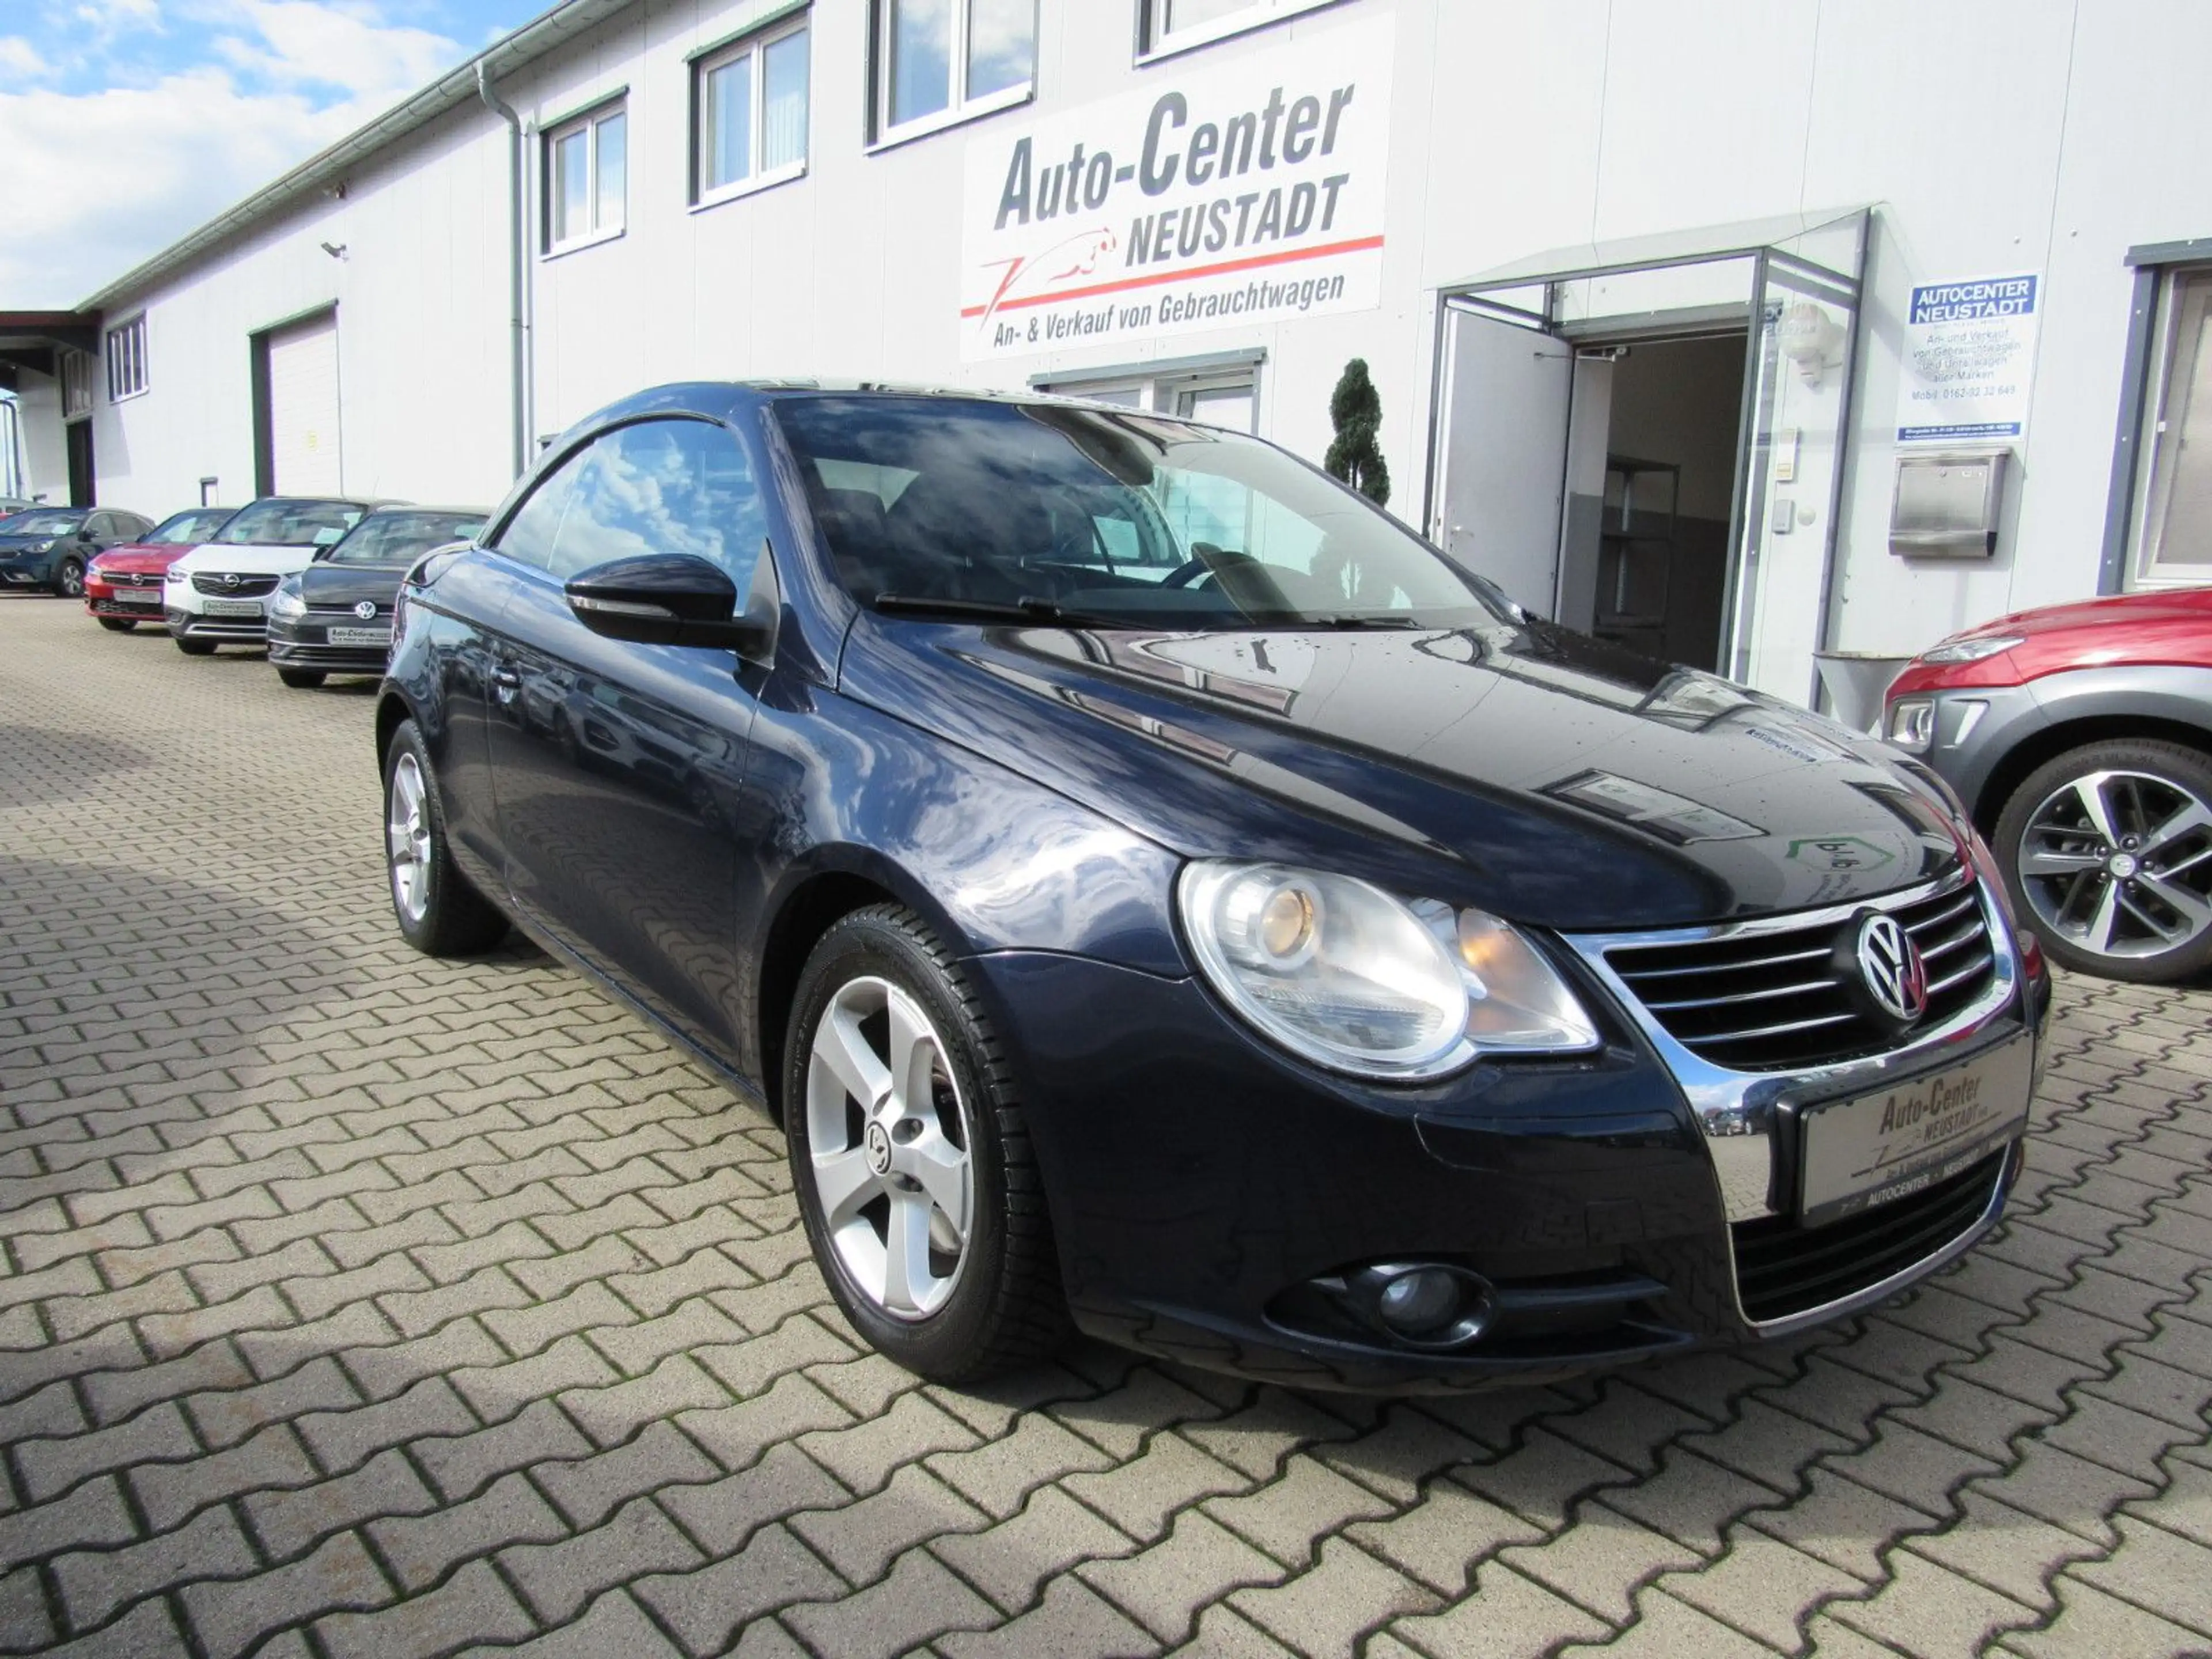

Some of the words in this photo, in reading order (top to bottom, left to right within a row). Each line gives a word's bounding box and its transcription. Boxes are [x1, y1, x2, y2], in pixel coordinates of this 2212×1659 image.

[994, 83, 1355, 230] Auto-Center
[1125, 173, 1350, 267] NEUSTADT
[994, 316, 1021, 348] An-
[1027, 316, 1039, 343] &
[1046, 305, 1113, 340] Verkauf
[1119, 302, 1152, 330] von
[1158, 274, 1345, 325] Gebrauchtwagen
[1916, 298, 2027, 322] NEUSTADT
[1918, 280, 2029, 305] AUTOCENTER
[1878, 1077, 1982, 1135] Auto-Center
[1868, 1173, 1930, 1207] AUTOCENTER
